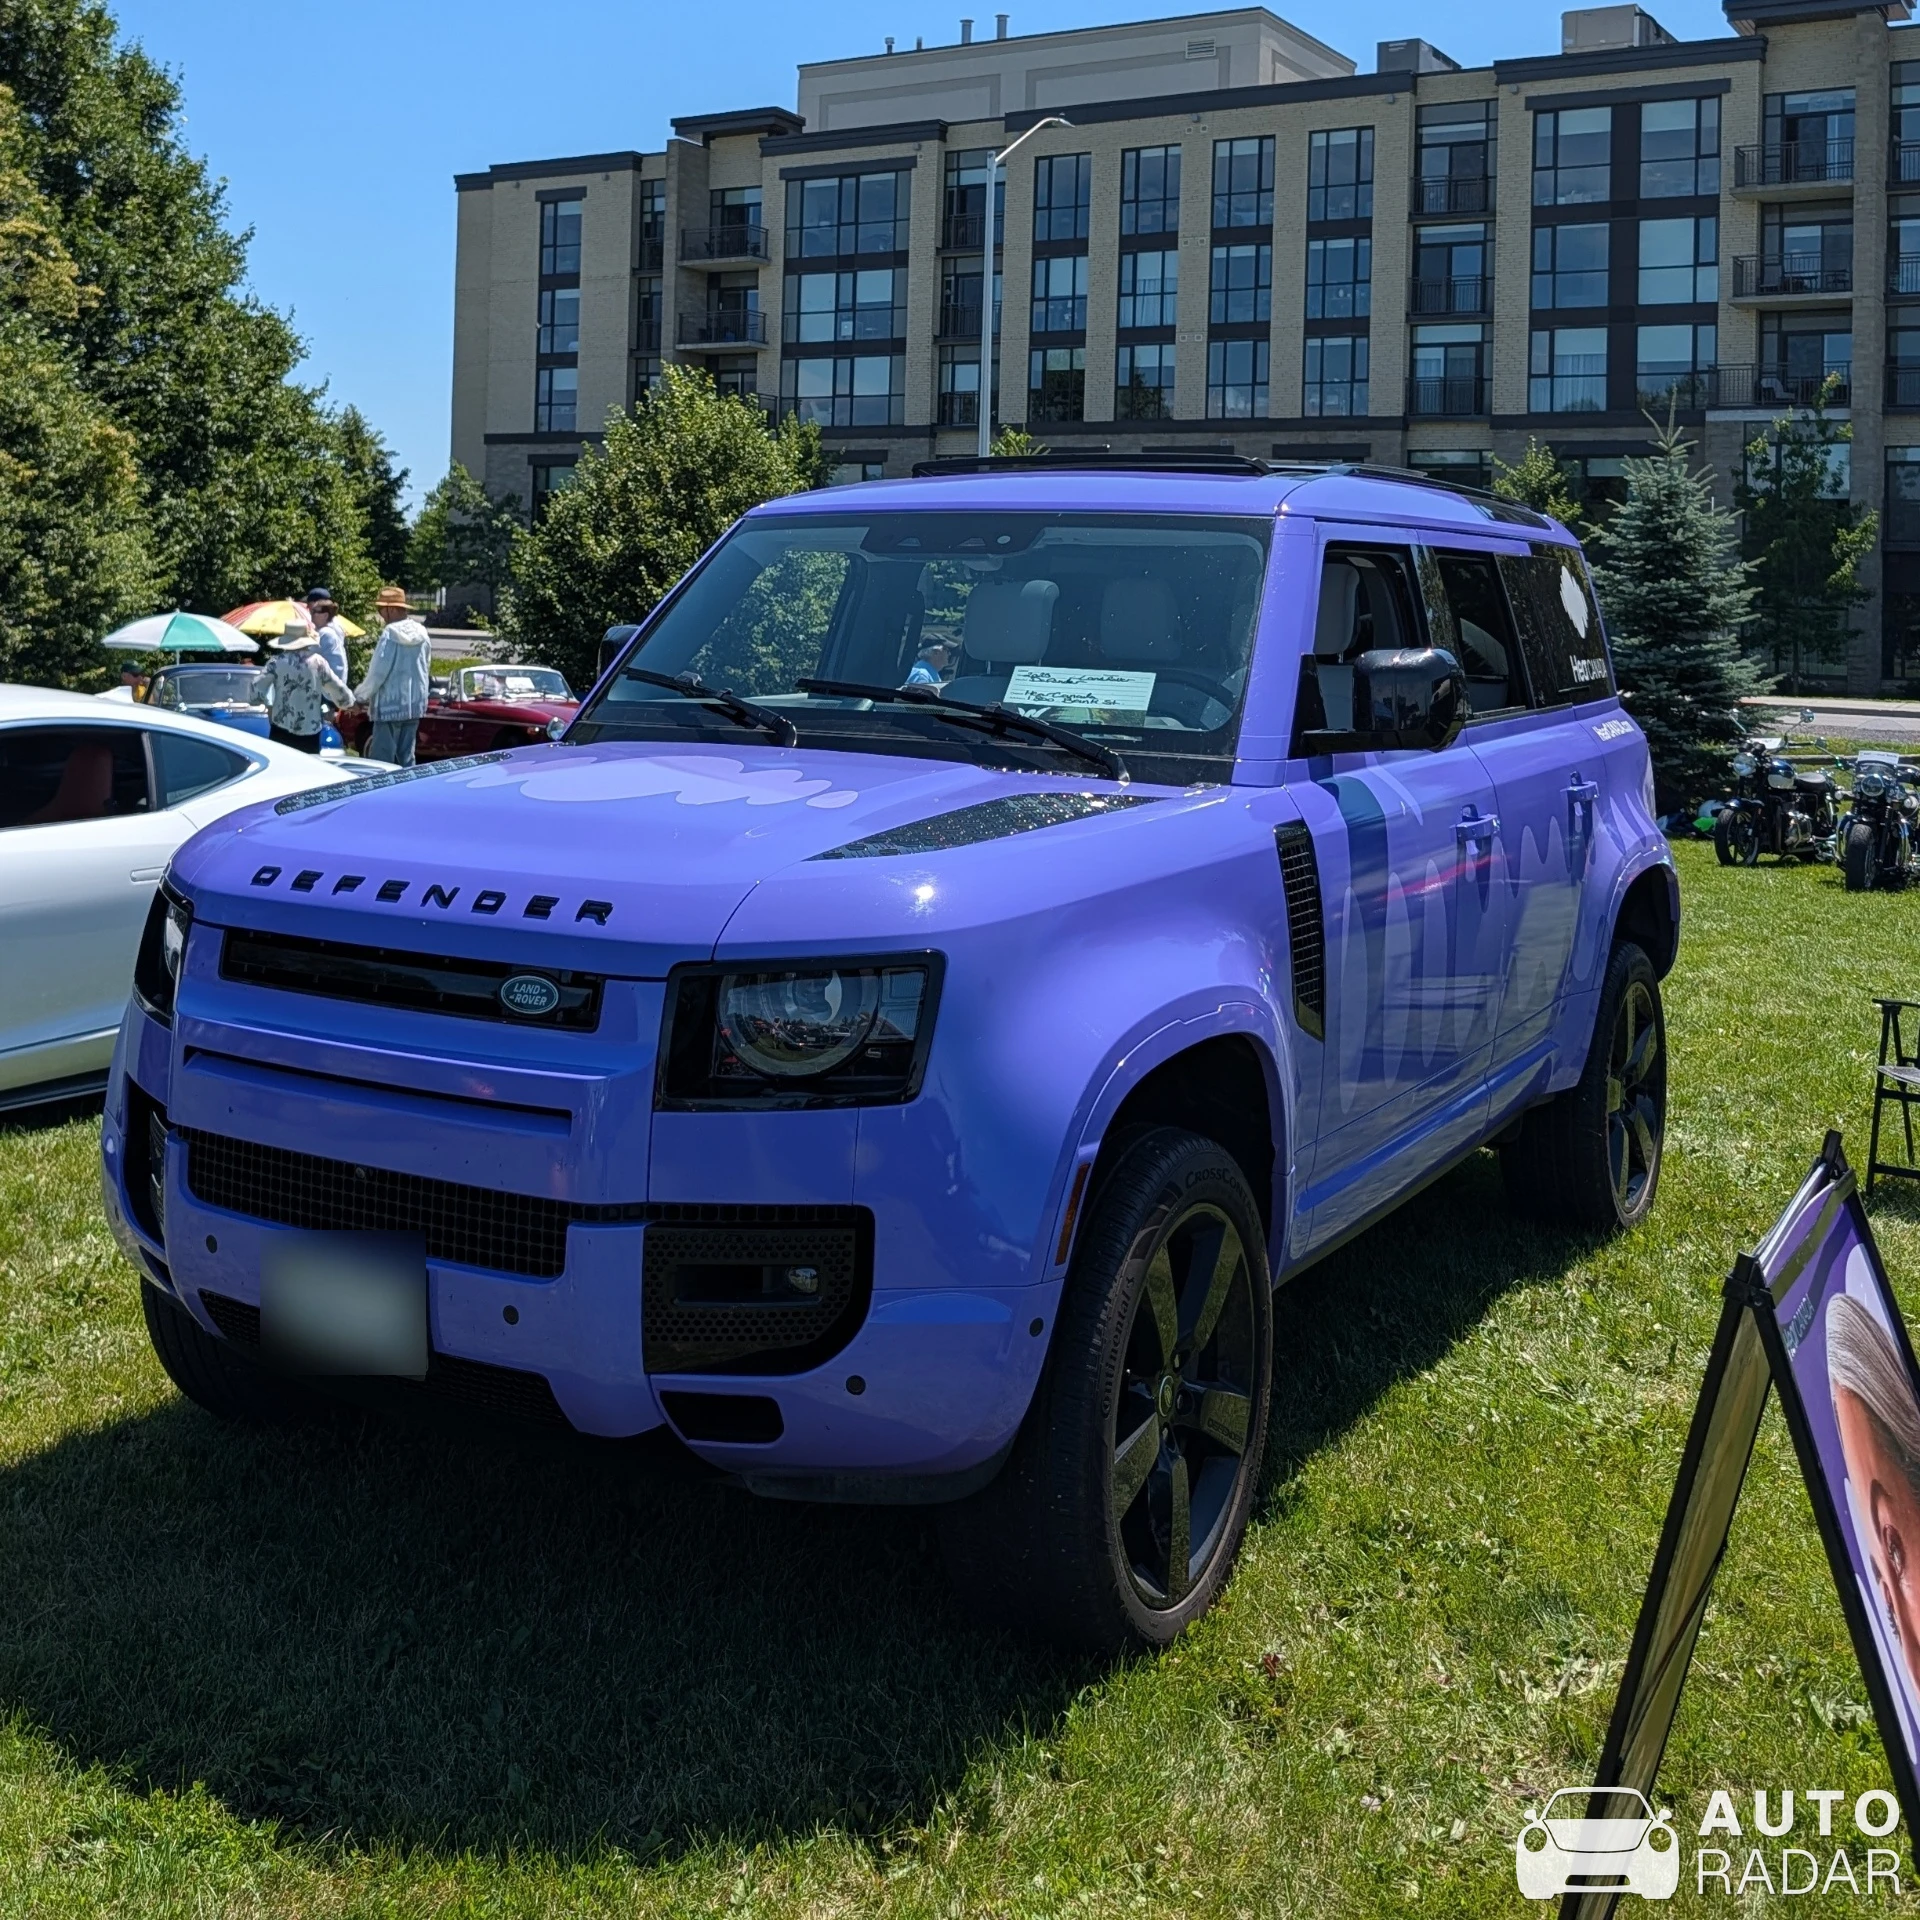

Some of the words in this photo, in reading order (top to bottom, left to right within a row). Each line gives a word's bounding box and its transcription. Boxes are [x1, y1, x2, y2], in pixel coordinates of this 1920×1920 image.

[250, 865, 614, 927] DEFENDER
[513, 982, 541, 996] LAND
[514, 993, 548, 1007] ROVER
